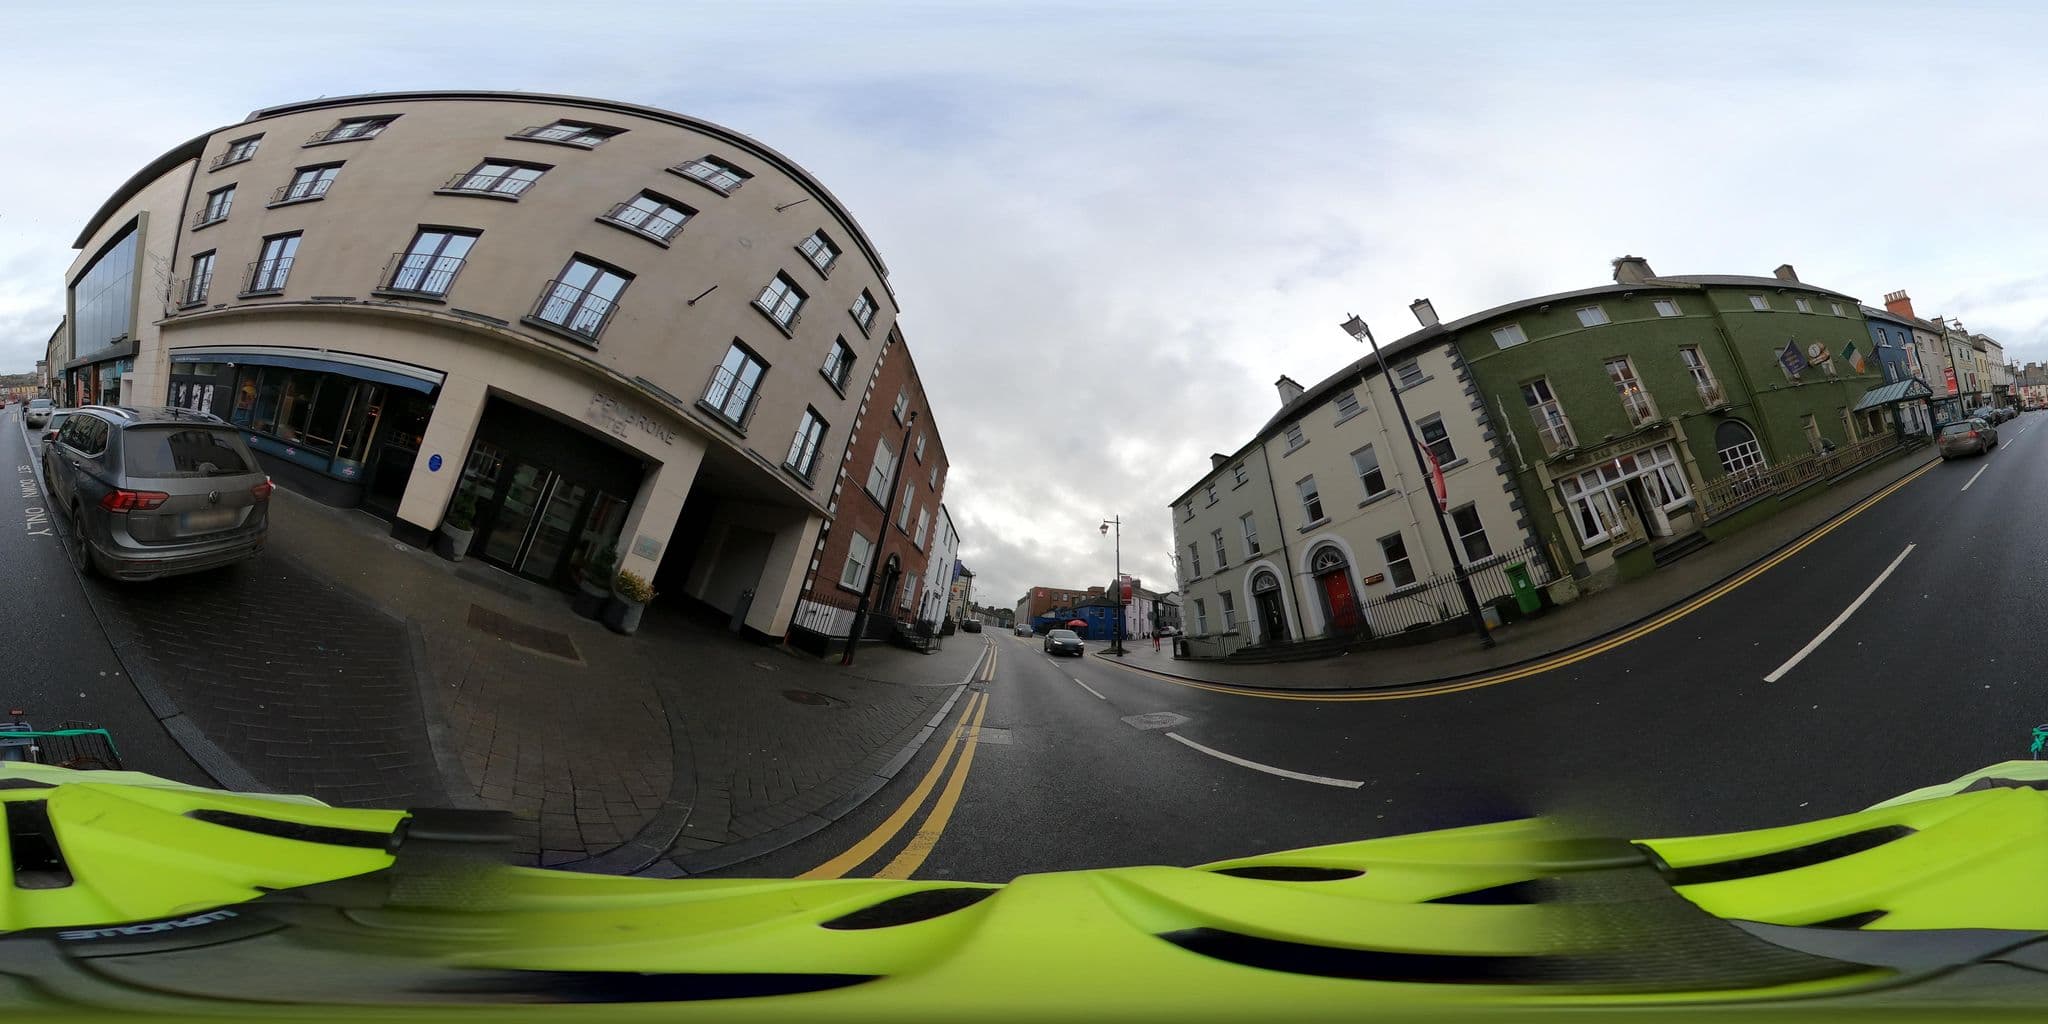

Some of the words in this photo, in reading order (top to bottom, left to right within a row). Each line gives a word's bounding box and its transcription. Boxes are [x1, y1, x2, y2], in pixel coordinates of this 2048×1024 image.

[592, 392, 676, 446] PEBROKE
[20, 479, 39, 498] DOWN
[25, 507, 53, 536] ONLY
